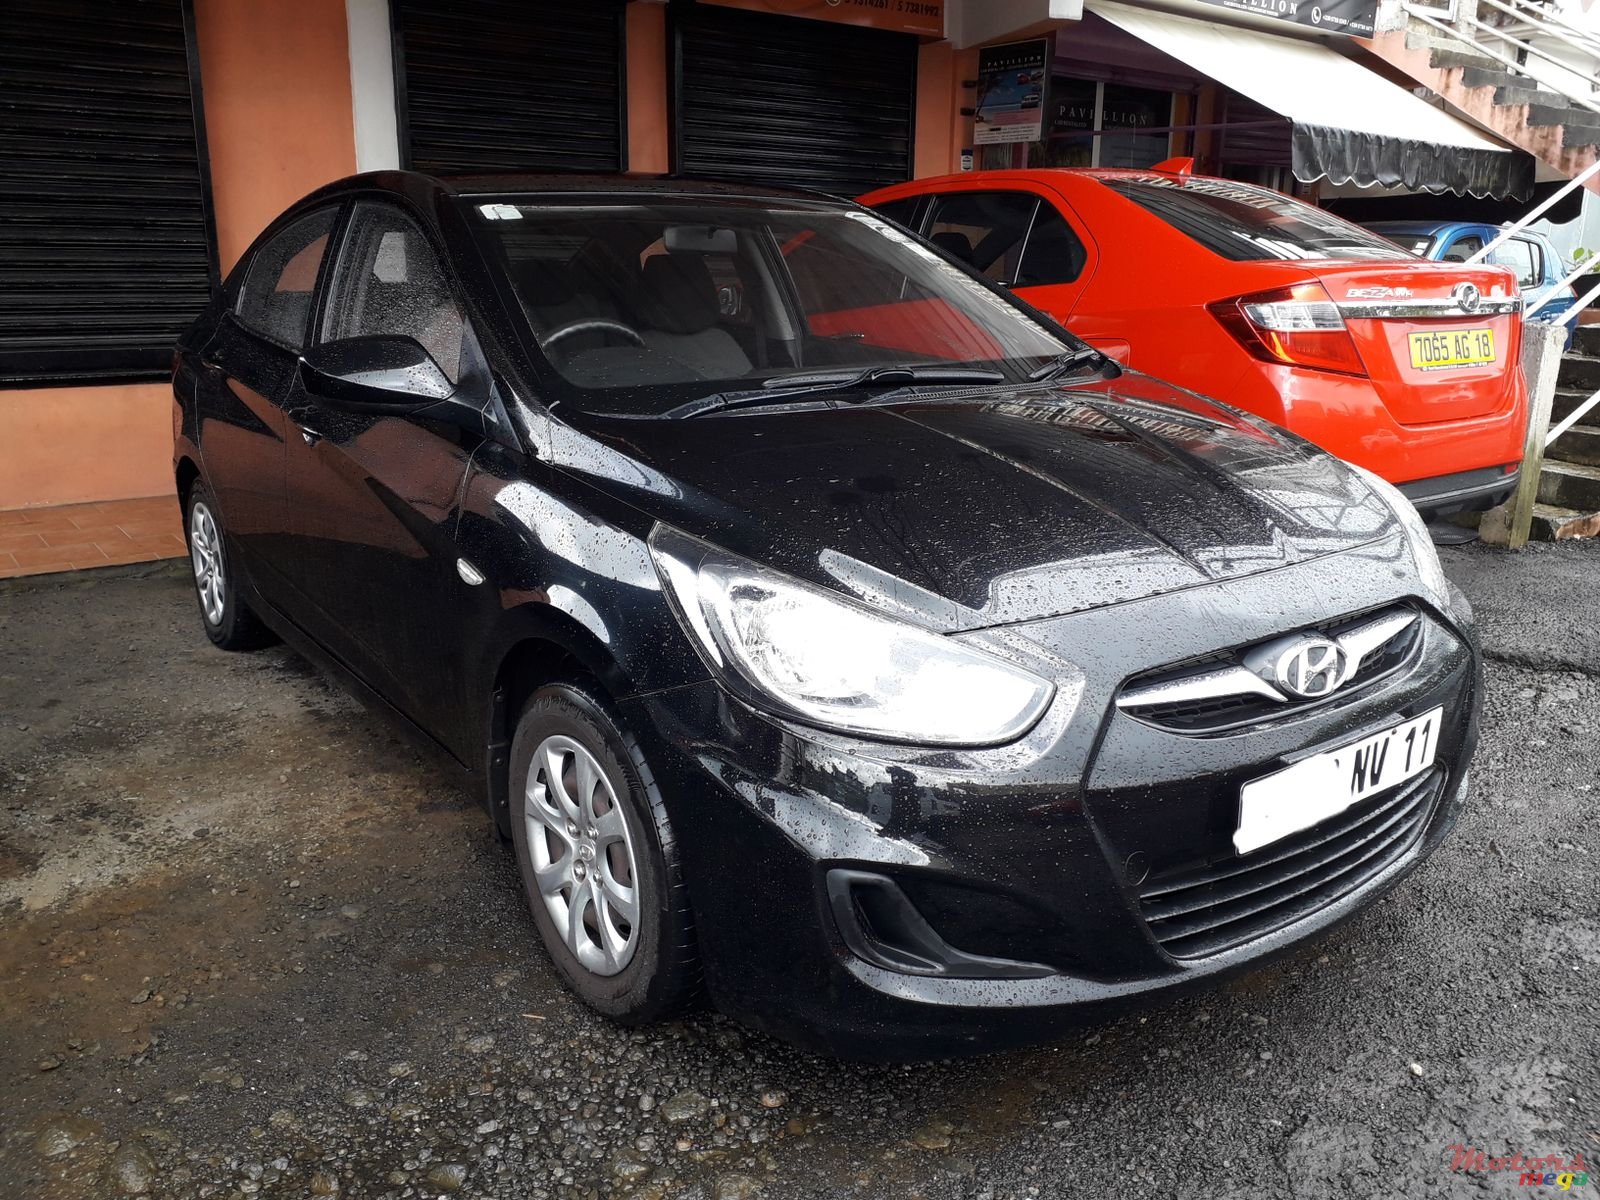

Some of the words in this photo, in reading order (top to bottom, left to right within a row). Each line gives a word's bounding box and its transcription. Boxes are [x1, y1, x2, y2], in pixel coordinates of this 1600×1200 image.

[1415, 335, 1449, 362] 7065
[1455, 334, 1470, 360] AG
[1475, 333, 1491, 358] 18
[1350, 736, 1390, 796] NV
[1404, 718, 1432, 773] 11
